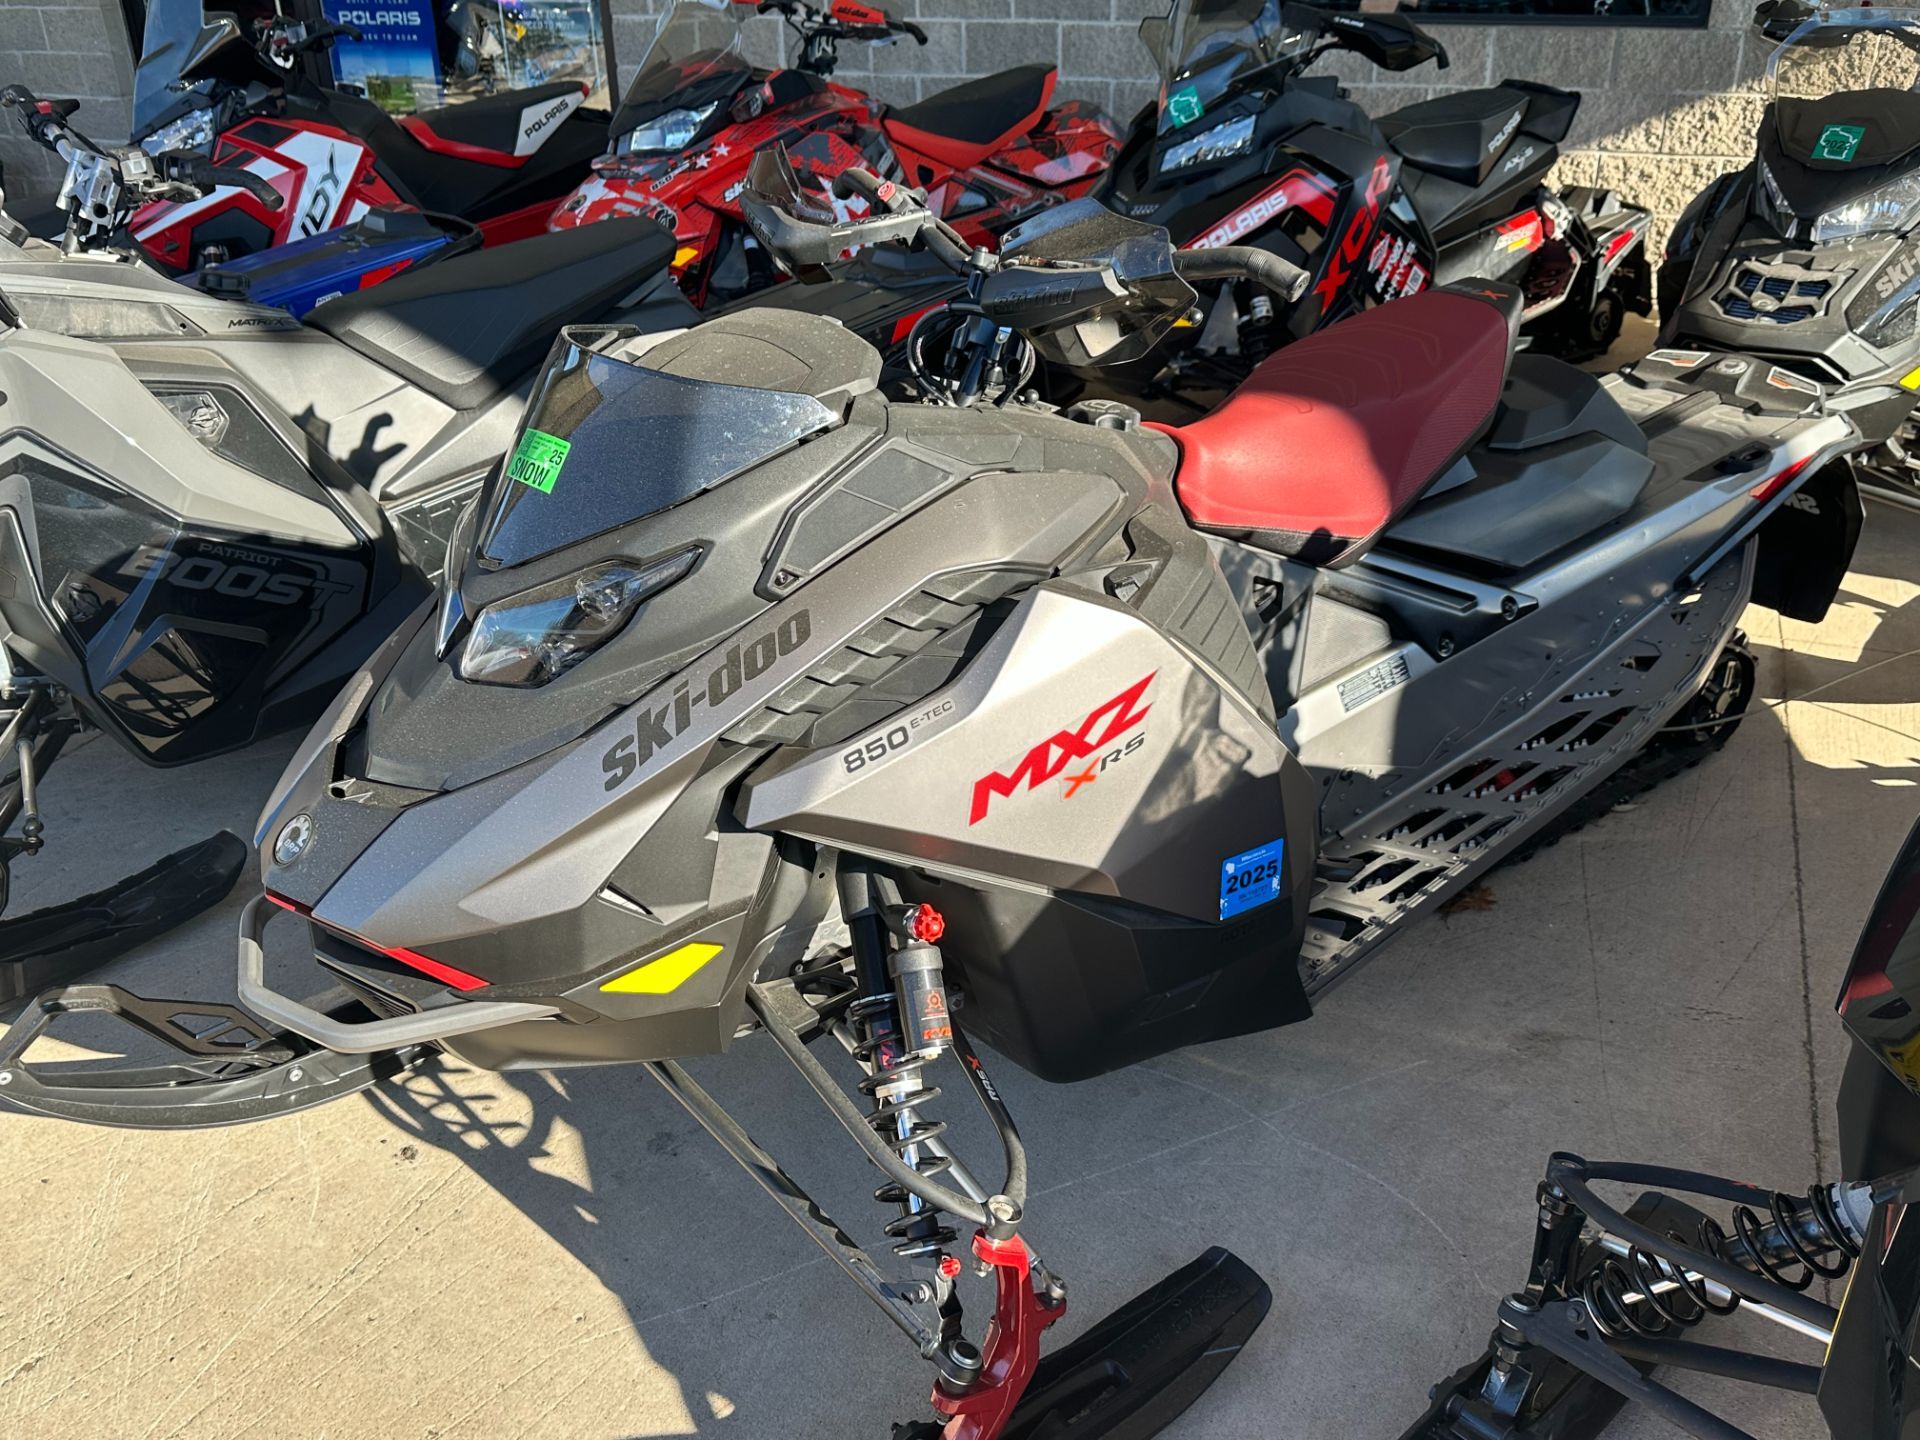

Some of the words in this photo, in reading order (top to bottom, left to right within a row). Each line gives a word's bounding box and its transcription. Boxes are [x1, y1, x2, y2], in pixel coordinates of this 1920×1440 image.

[338, 11, 421, 25] POLARIS
[524, 98, 569, 139] POLARIS
[1488, 110, 1521, 153] POLARIS
[1192, 189, 1289, 250] POLARIS
[1312, 154, 1392, 317] XCR
[511, 456, 551, 488] SNOW
[549, 448, 565, 466] 25
[199, 543, 282, 568] PATRIOT
[116, 544, 355, 611] BOOST
[843, 725, 910, 774] 850
[910, 700, 953, 729] E-TEC
[968, 667, 1162, 827] MXZ
[1225, 859, 1278, 895] 2025
